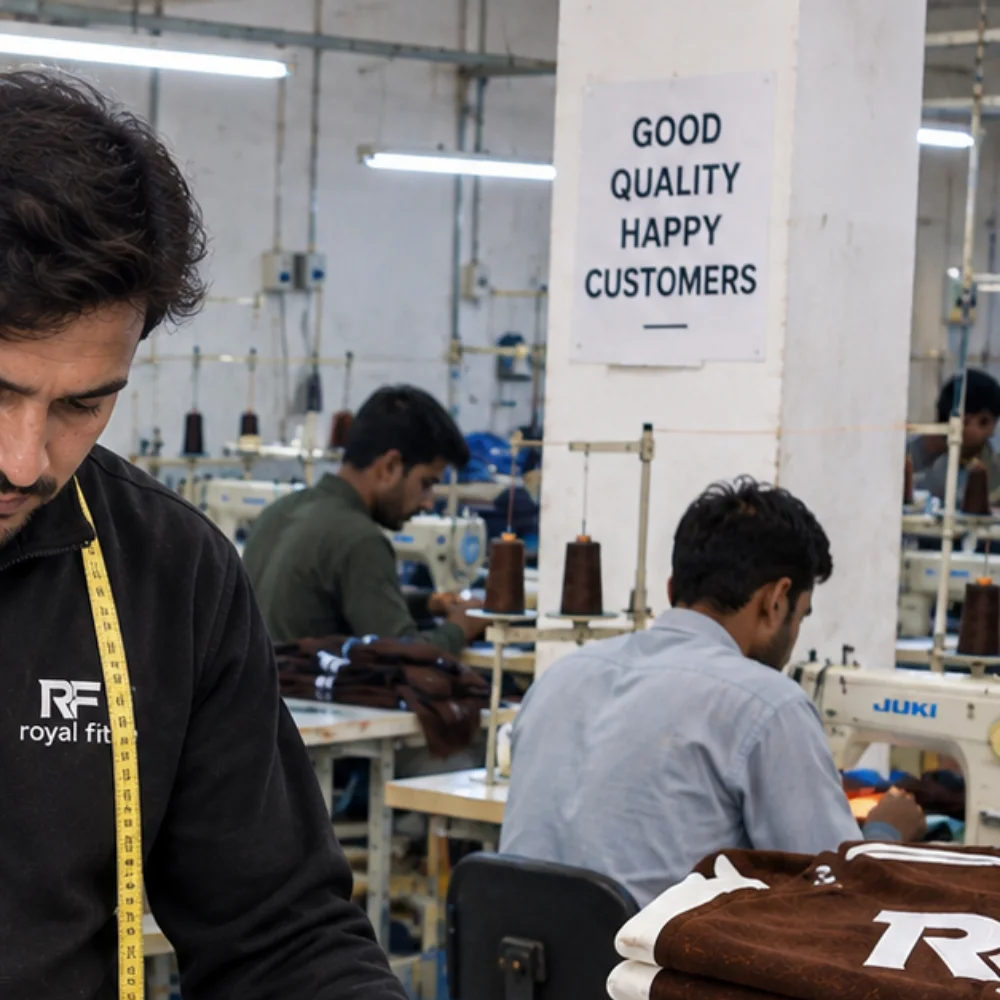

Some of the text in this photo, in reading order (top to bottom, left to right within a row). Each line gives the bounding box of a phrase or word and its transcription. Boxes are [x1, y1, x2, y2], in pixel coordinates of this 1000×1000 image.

[633, 113, 721, 148] GOOD
[611, 162, 740, 201] QUALITY
[621, 215, 721, 249] HAPPY
[585, 264, 756, 299] CUSTOMERS
[39, 680, 101, 719] RF
[873, 698, 936, 718] JUKI
[20, 721, 111, 746] royal fit
[863, 910, 1000, 981] R
